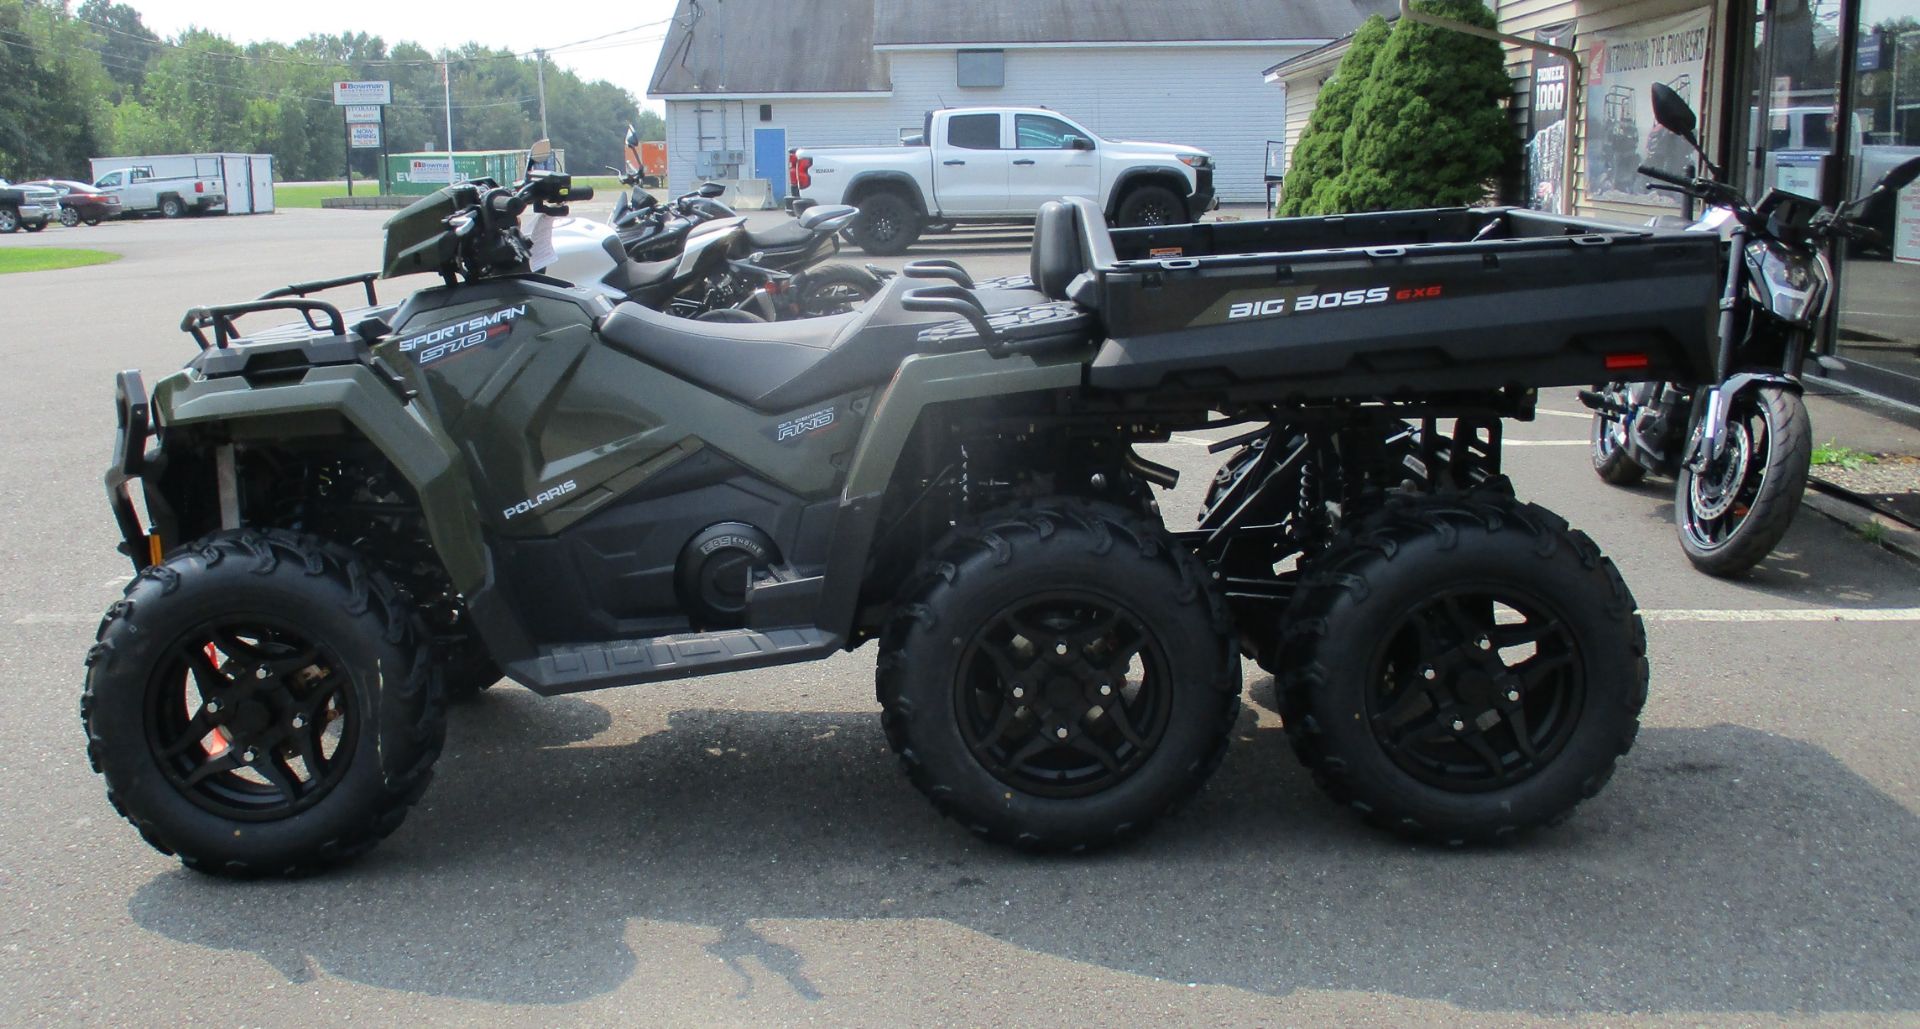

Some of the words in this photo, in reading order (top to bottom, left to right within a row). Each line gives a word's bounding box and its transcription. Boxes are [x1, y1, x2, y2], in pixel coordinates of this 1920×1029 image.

[1651, 36, 1665, 67] THE
[1667, 27, 1705, 64] PIONEERS
[1537, 65, 1565, 83] PIONEER
[1535, 82, 1564, 111] 1000
[1228, 299, 1285, 319] BIG
[1295, 286, 1390, 312] BOSS
[399, 304, 526, 352] SPORTSMAN
[420, 330, 487, 364] 570
[778, 412, 834, 441] AWD
[503, 479, 577, 520] POLARIS
